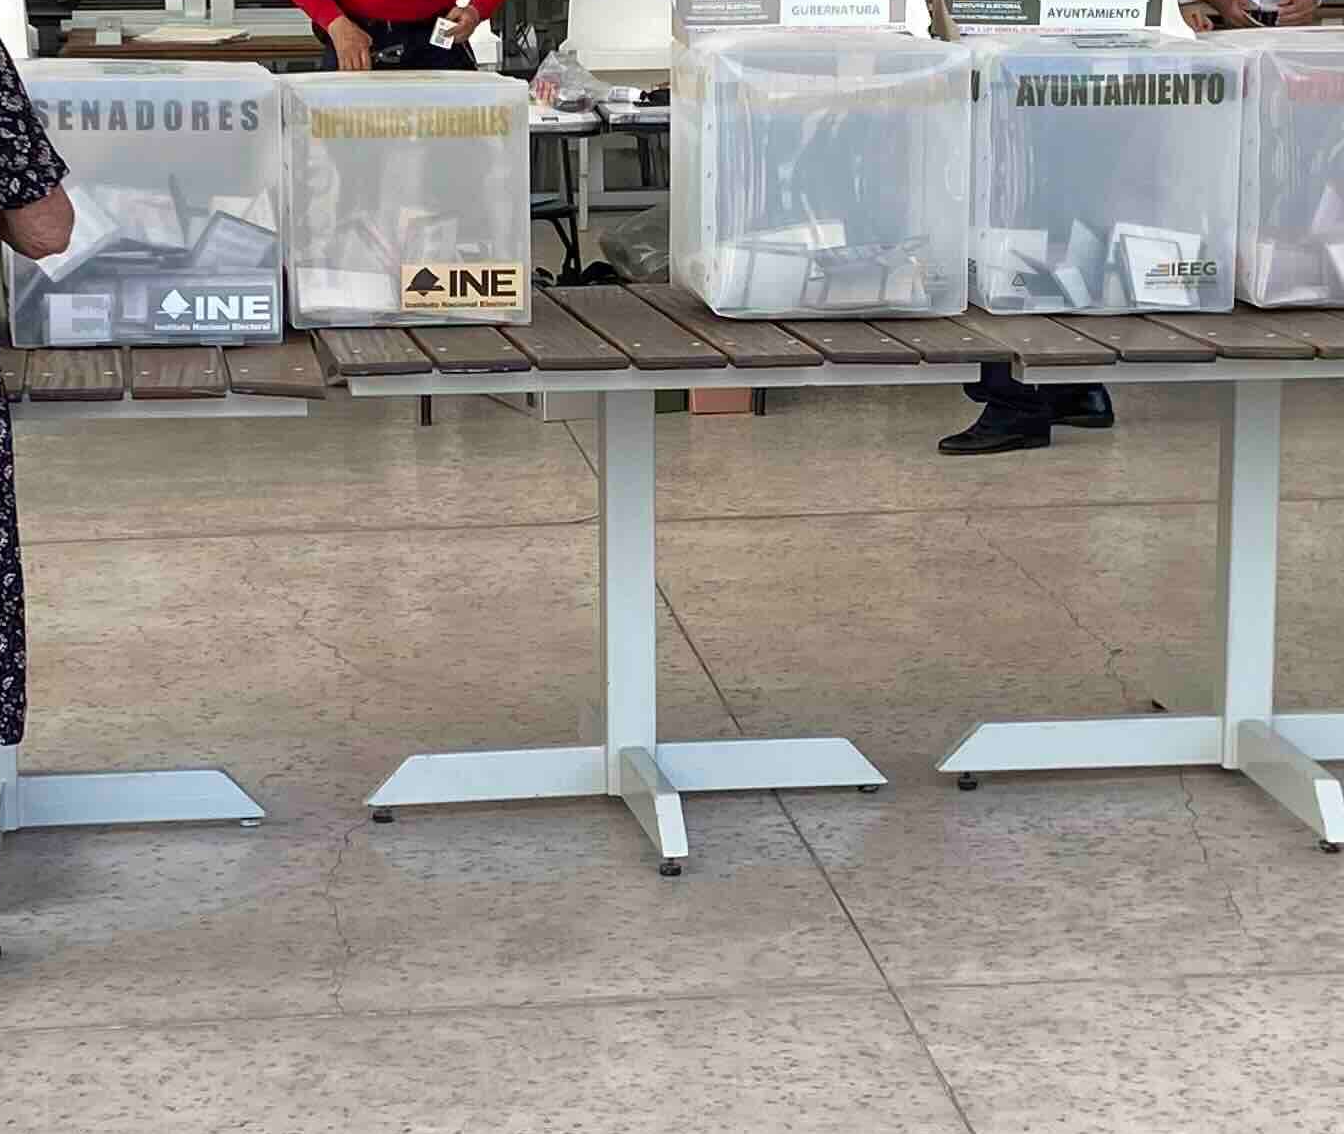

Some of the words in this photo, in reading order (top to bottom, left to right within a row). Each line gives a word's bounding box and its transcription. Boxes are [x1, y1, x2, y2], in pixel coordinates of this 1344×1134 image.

[791, 4, 881, 16] GUBERNATURA
[1047, 8, 1140, 19] AYUNTAMIENTO
[1016, 73, 1224, 106] AYUNTAMIENTO
[38, 98, 258, 132] SENADORES
[416, 105, 511, 136] FEDERALES
[1169, 260, 1217, 276] IEEG
[449, 269, 517, 297] INE
[195, 296, 271, 321] INE
